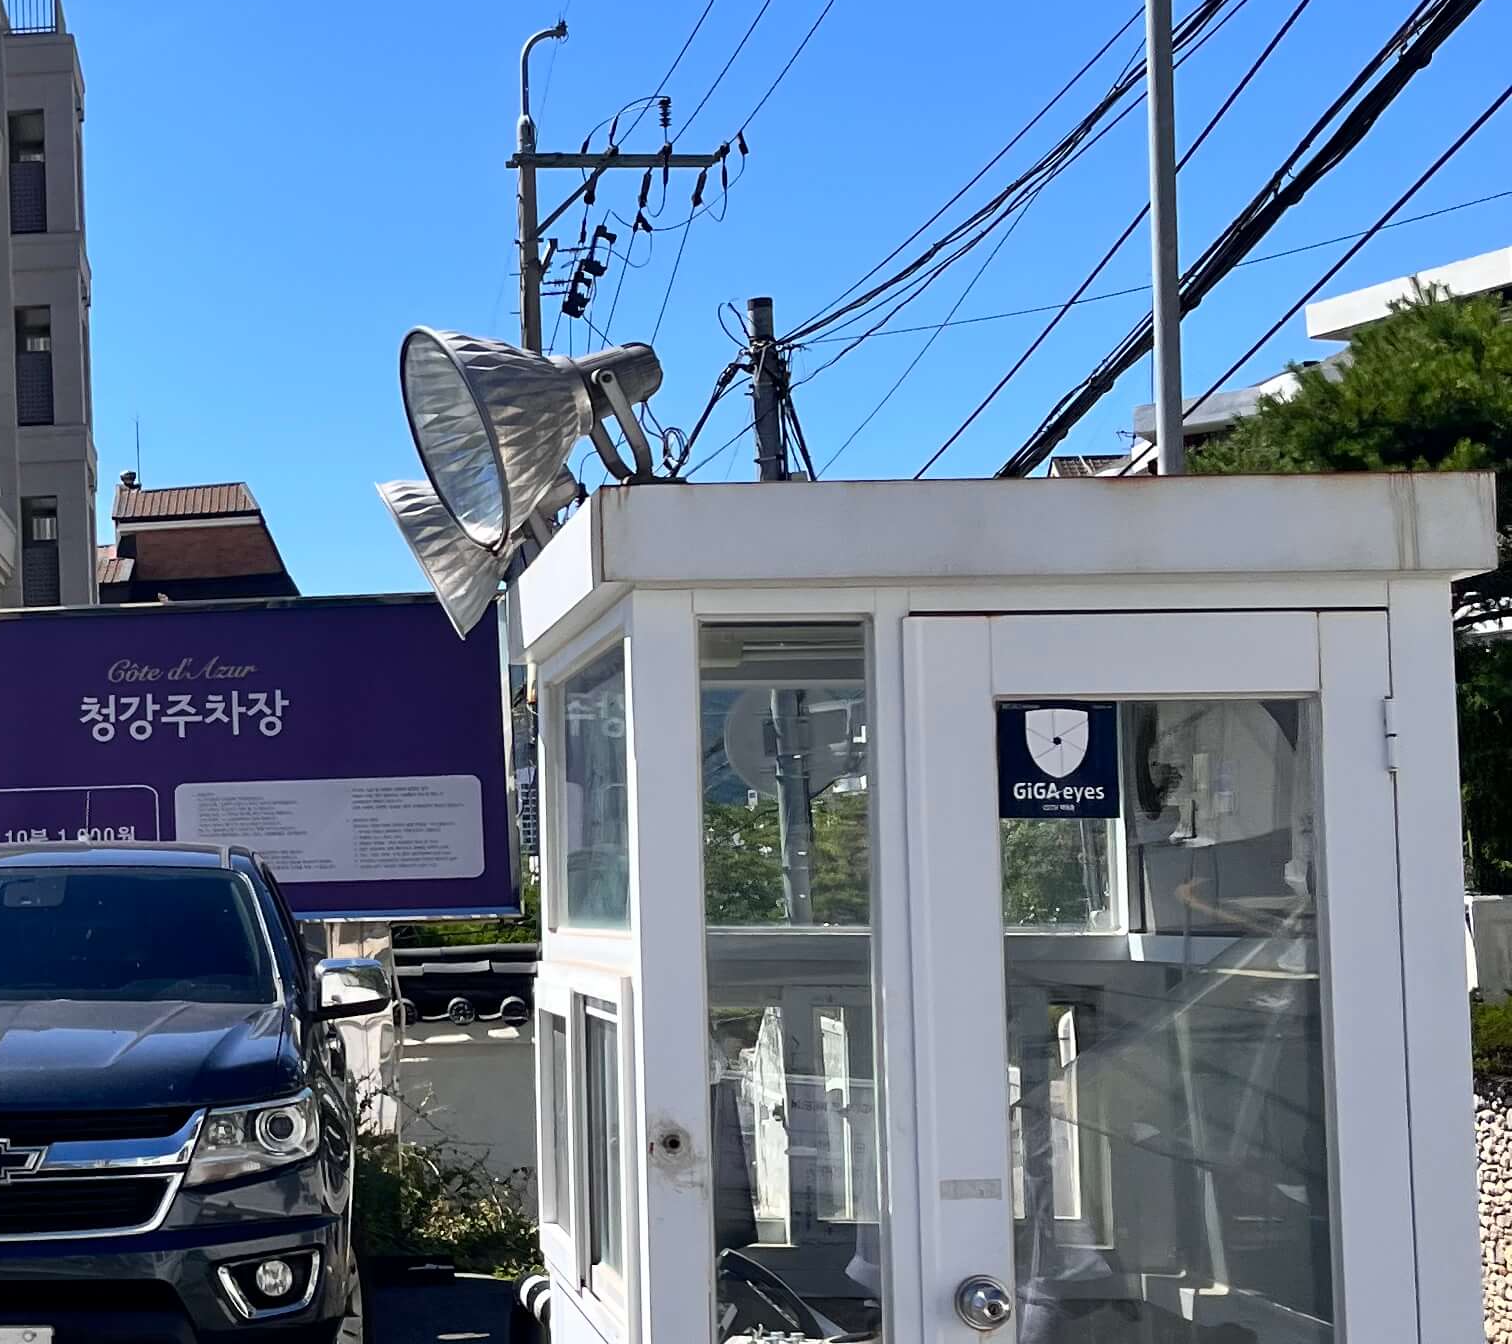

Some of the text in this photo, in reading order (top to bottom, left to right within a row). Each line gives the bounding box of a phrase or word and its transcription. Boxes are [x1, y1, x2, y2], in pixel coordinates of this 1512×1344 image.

[107, 656, 259, 683] Côte d'Azur
[79, 689, 290, 742] 청강주차장
